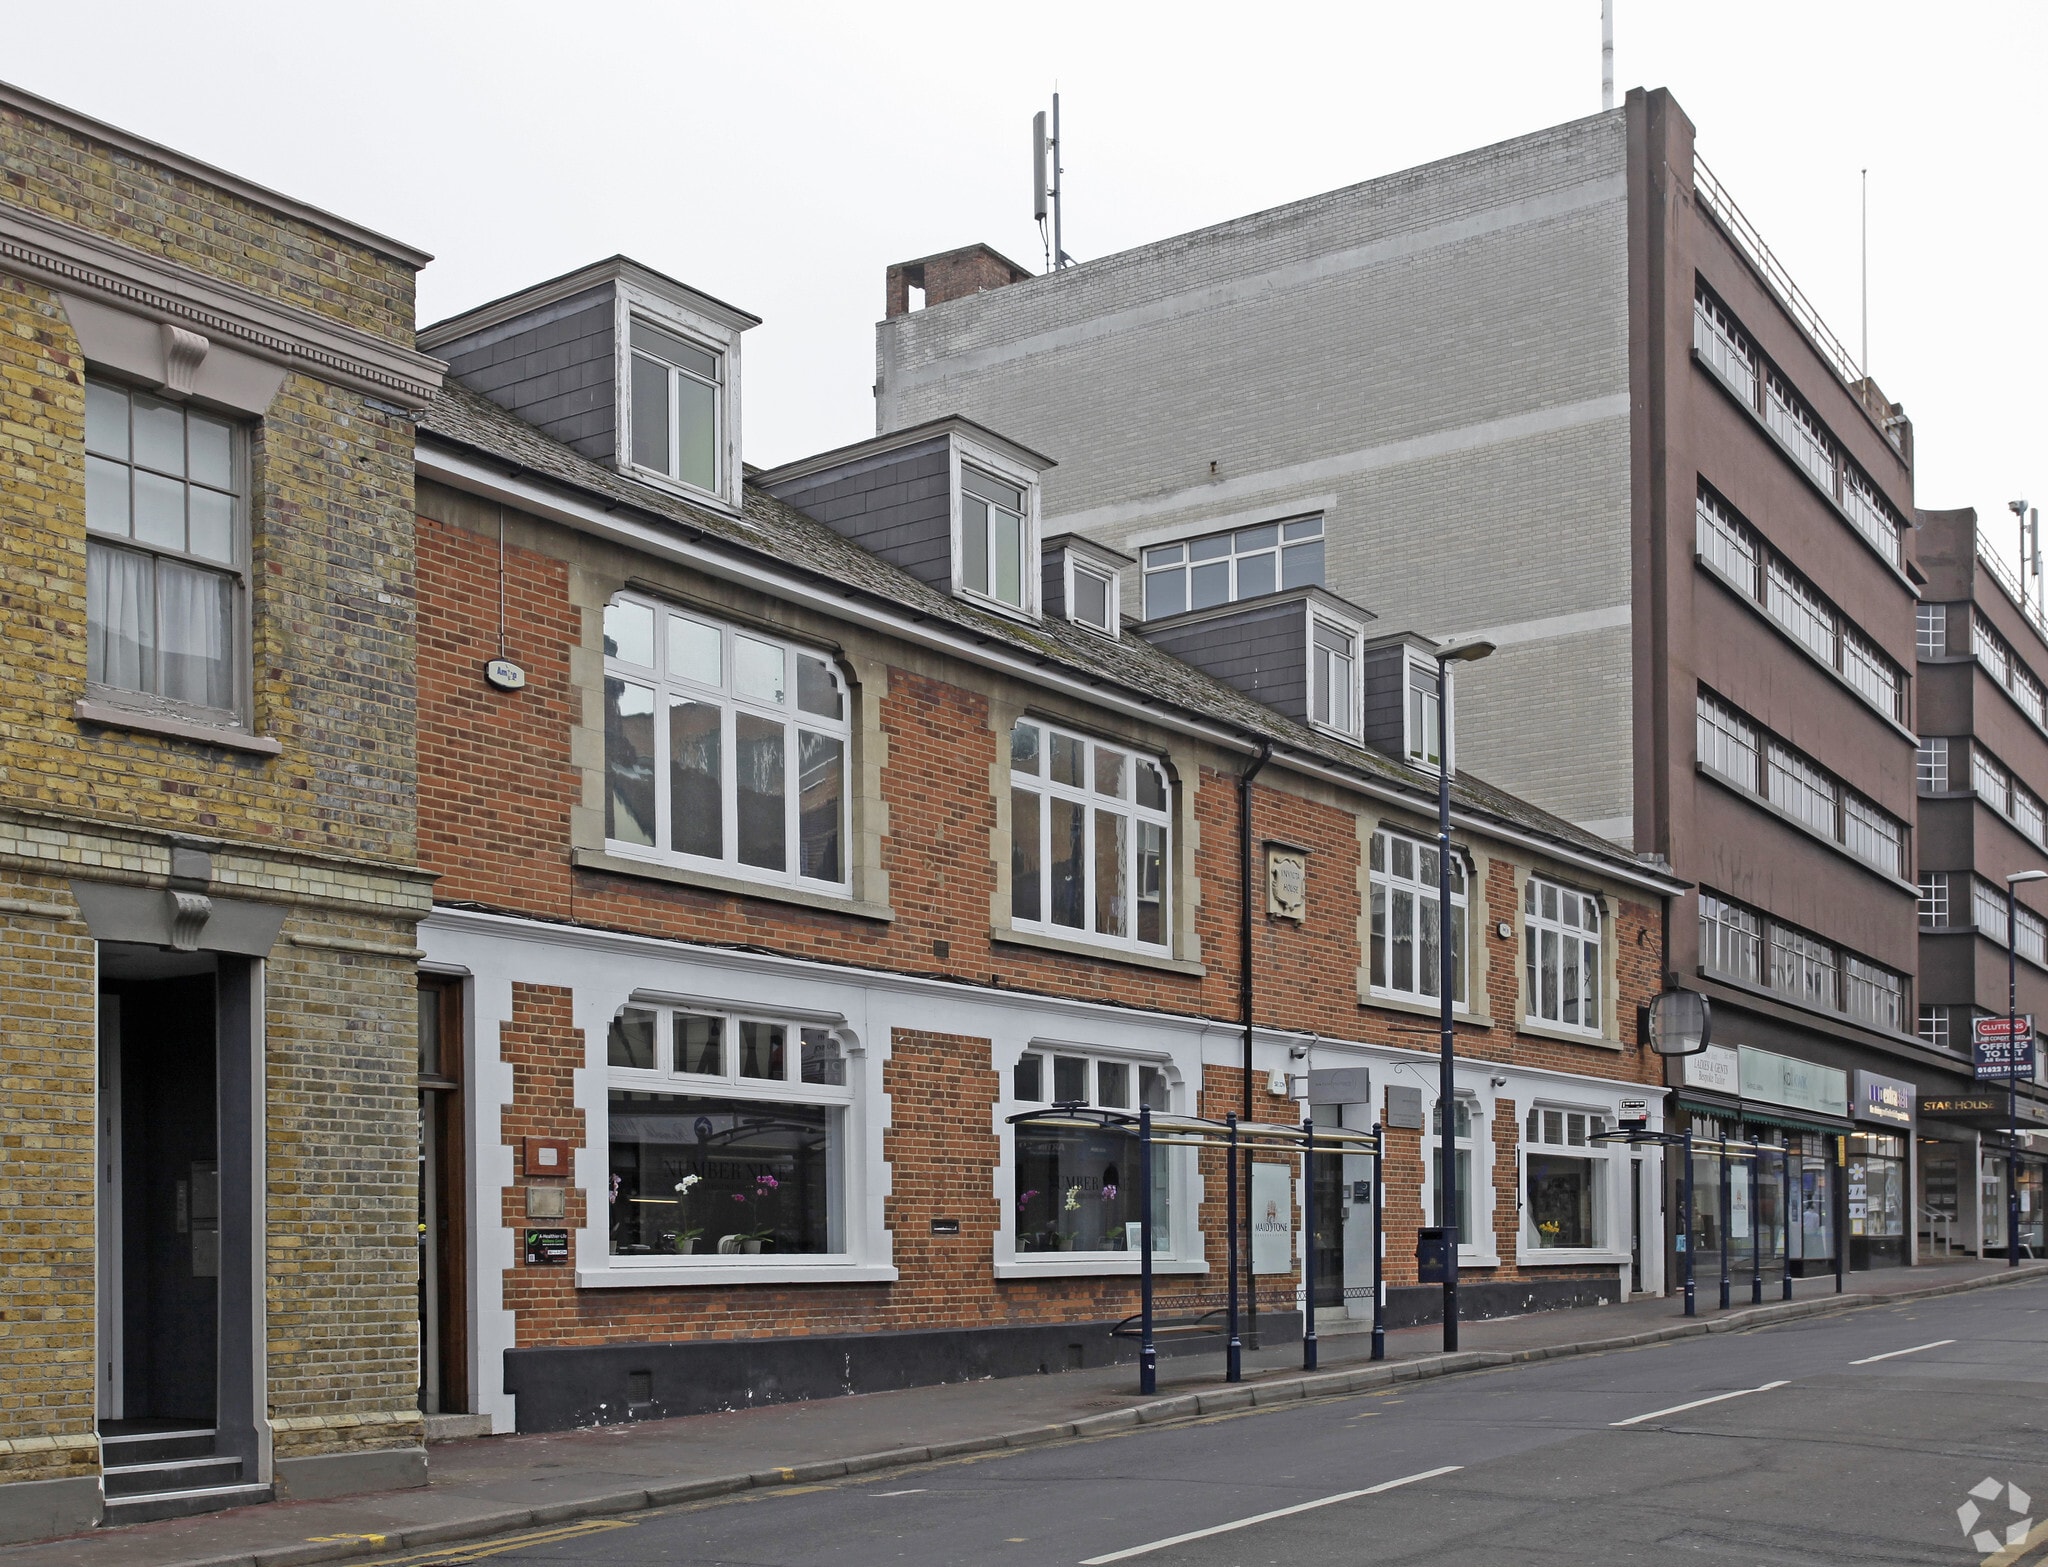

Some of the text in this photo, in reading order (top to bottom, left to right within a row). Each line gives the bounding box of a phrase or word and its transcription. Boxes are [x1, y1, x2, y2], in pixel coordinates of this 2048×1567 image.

[1283, 883, 1299, 894] HOUSE
[1984, 1049, 2024, 1058] TO LT
[1923, 1100, 1995, 1111] STAR HOUSE
[663, 1159, 742, 1180] NUMBER
